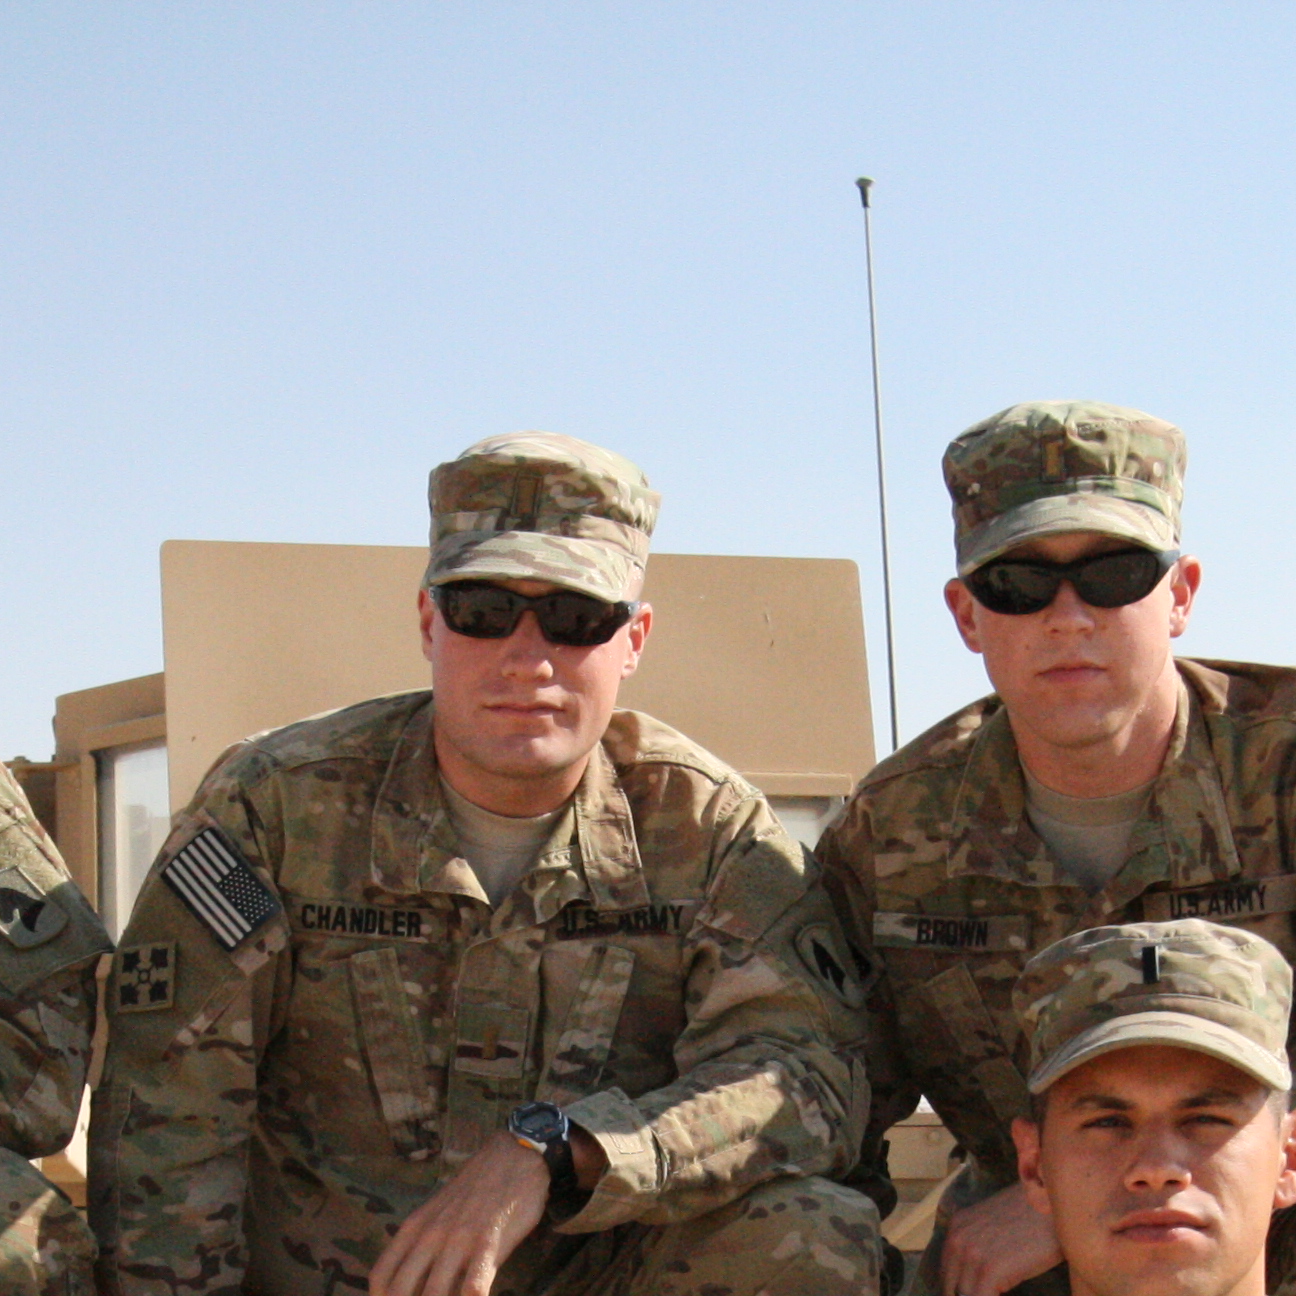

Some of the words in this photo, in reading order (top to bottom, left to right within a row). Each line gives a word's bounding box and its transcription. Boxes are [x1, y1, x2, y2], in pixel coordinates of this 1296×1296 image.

[1207, 884, 1266, 916] ARMY
[301, 903, 422, 938] CHANDLER
[618, 904, 684, 931] ARMY
[916, 917, 989, 947] BROWN
